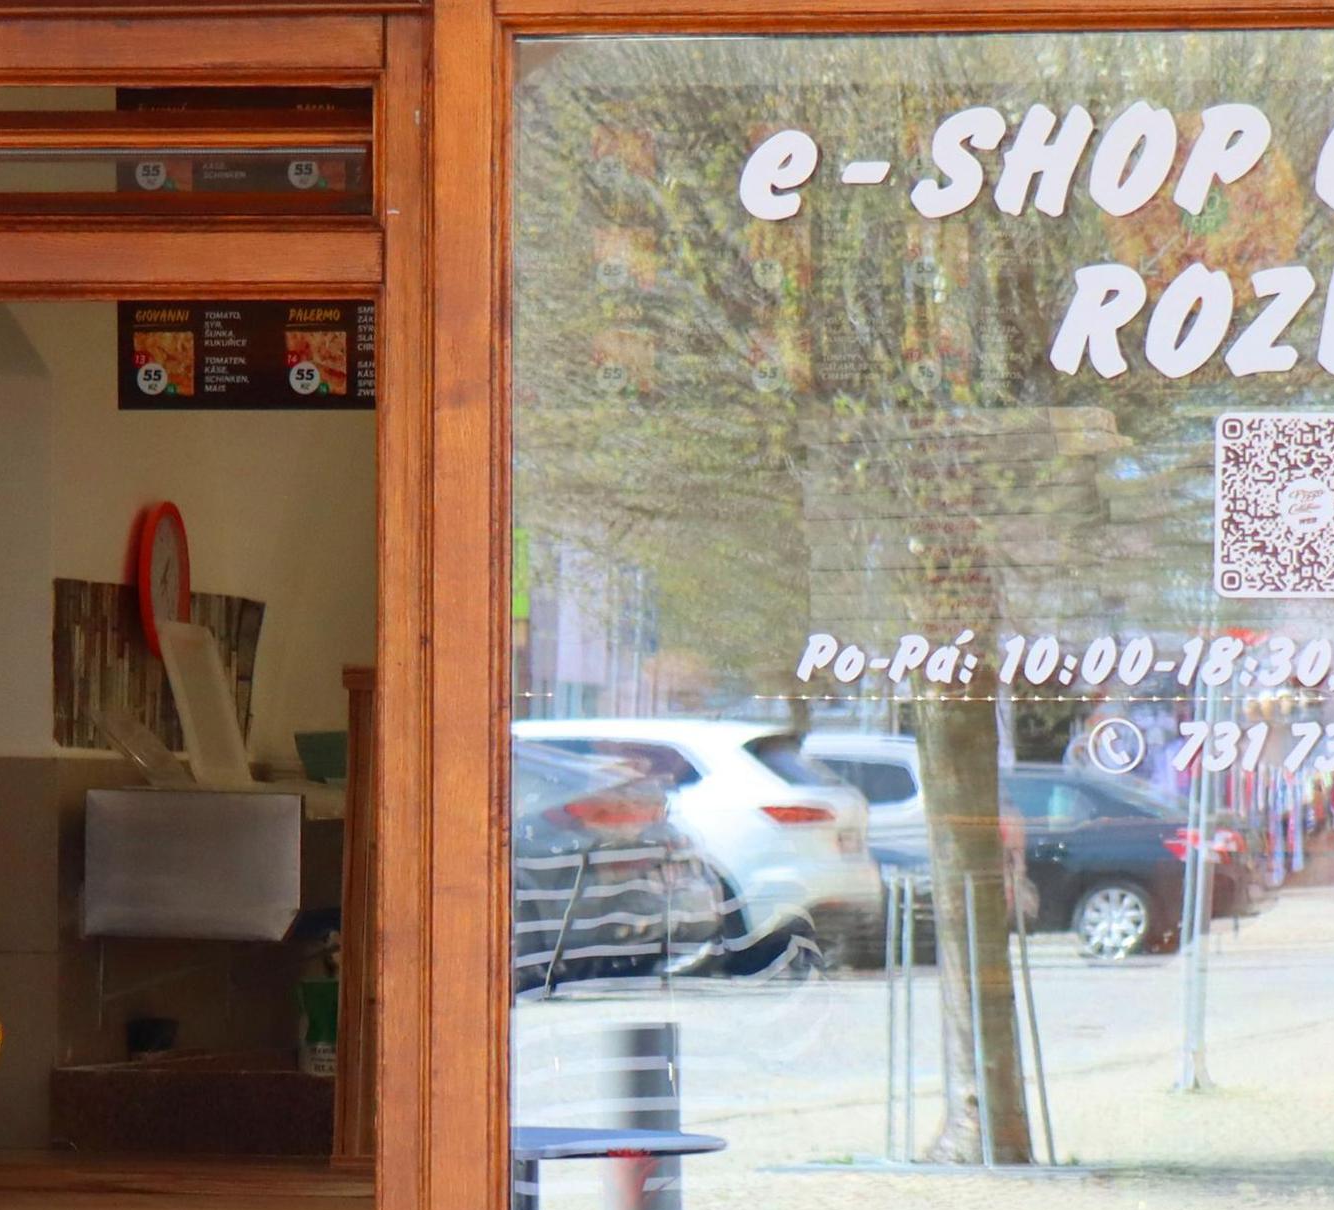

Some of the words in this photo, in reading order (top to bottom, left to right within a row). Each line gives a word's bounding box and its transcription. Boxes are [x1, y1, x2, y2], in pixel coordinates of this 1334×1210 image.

[141, 165, 160, 177] 55
[294, 164, 313, 176] 55
[135, 310, 190, 322] GIOVANNI
[205, 312, 241, 320] TOMATO,
[289, 309, 341, 321] PALERMO
[143, 370, 162, 382] 55
[295, 369, 315, 380] 55
[1173, 722, 1268, 772] 731
